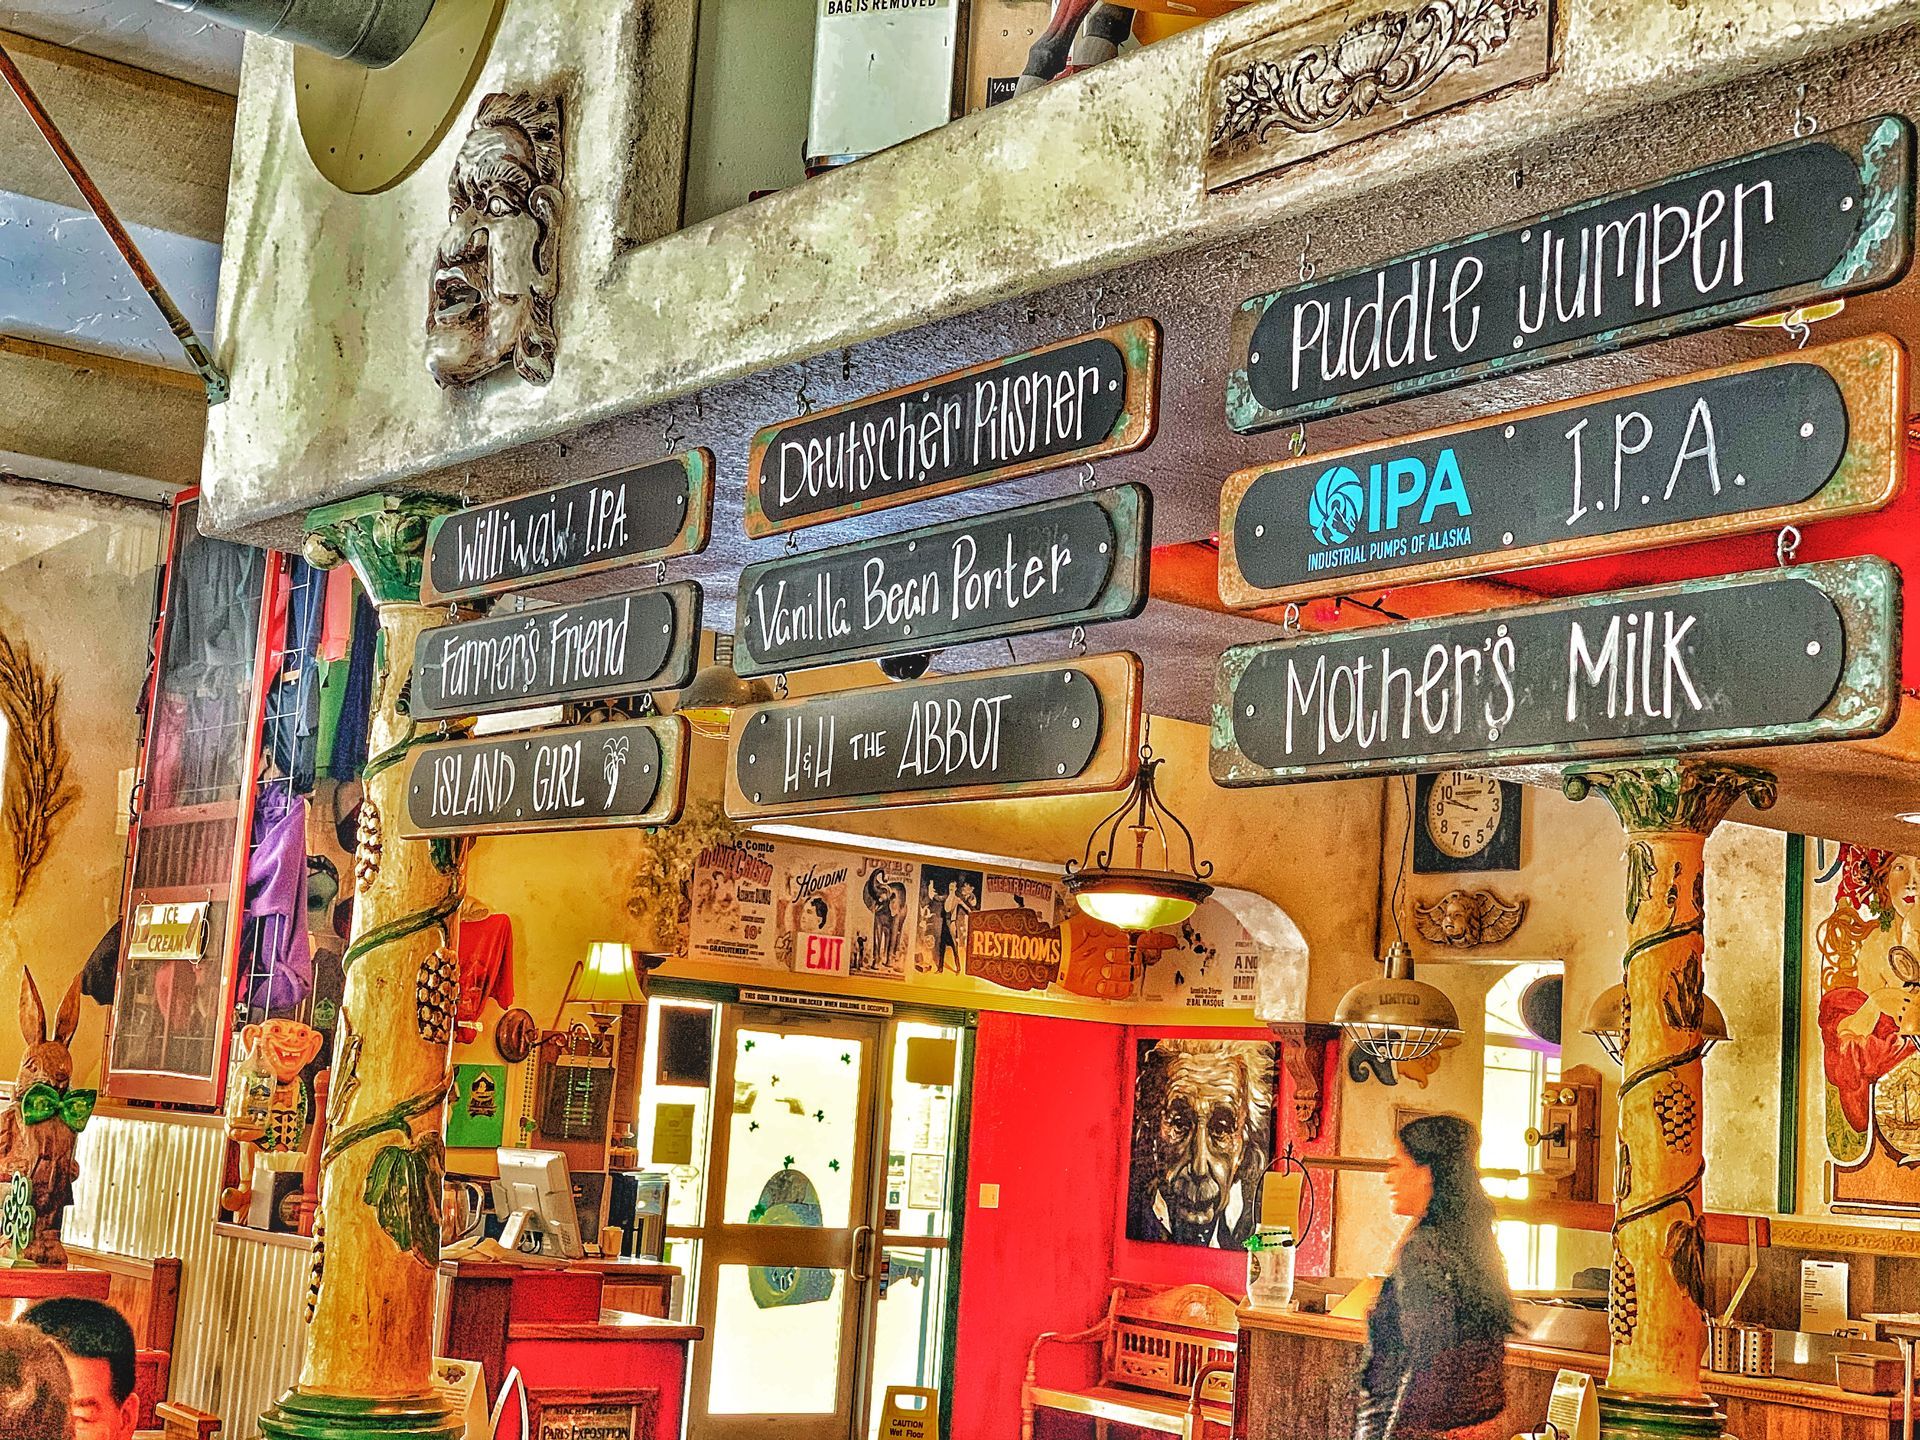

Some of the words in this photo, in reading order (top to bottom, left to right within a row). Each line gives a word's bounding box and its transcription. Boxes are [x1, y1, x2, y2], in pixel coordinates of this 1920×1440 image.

[828, 1, 852, 14] BAG
[856, 0, 868, 11] IS
[1290, 254, 1483, 391] Puddle
[780, 401, 962, 506] Deutscher
[973, 365, 1099, 467] Pilsner
[1368, 448, 1472, 533] IPA
[457, 501, 574, 583] Williwaw
[1307, 545, 1366, 572] INDUSTRIAL
[1370, 537, 1407, 562] PUMPS
[1411, 534, 1425, 554] OF
[1428, 526, 1471, 551] ALASKA
[755, 570, 851, 651] Vanilla
[862, 557, 939, 631] Bean
[950, 534, 1072, 620] Porter
[440, 624, 540, 699] Farmer's
[549, 597, 630, 687] Friend
[1284, 636, 1516, 756] Mother's
[784, 714, 835, 794] H&H
[849, 729, 887, 761] THE
[896, 694, 1012, 779] ABBOT
[430, 753, 514, 818] ISLAND
[532, 740, 585, 812] GIRL
[1487, 779, 1496, 794] 2
[1441, 785, 1453, 800] 10
[1436, 801, 1444, 816] 9
[1491, 797, 1500, 812] 3
[1440, 819, 1448, 834] 8
[1485, 816, 1494, 831] 4
[1451, 831, 1460, 846] 7
[1462, 834, 1470, 849] 6
[1476, 829, 1484, 843] 5
[745, 840, 775, 853] Comte
[791, 864, 848, 904] HOUDINI
[162, 906, 179, 924] ICE
[147, 934, 184, 953] CREAM
[972, 930, 1060, 964] RESTROOMS
[806, 935, 844, 971] EXIT
[779, 995, 798, 1004] REMAIN
[799, 997, 823, 1006] UNLOCKED
[824, 999, 838, 1007] WHEN
[867, 1003, 889, 1013] OCCUPIED
[543, 1425, 570, 1440] PARIS
[892, 1419, 924, 1429] CAUTION
[889, 1428, 903, 1437] Wet
[906, 1429, 924, 1439] Floor
